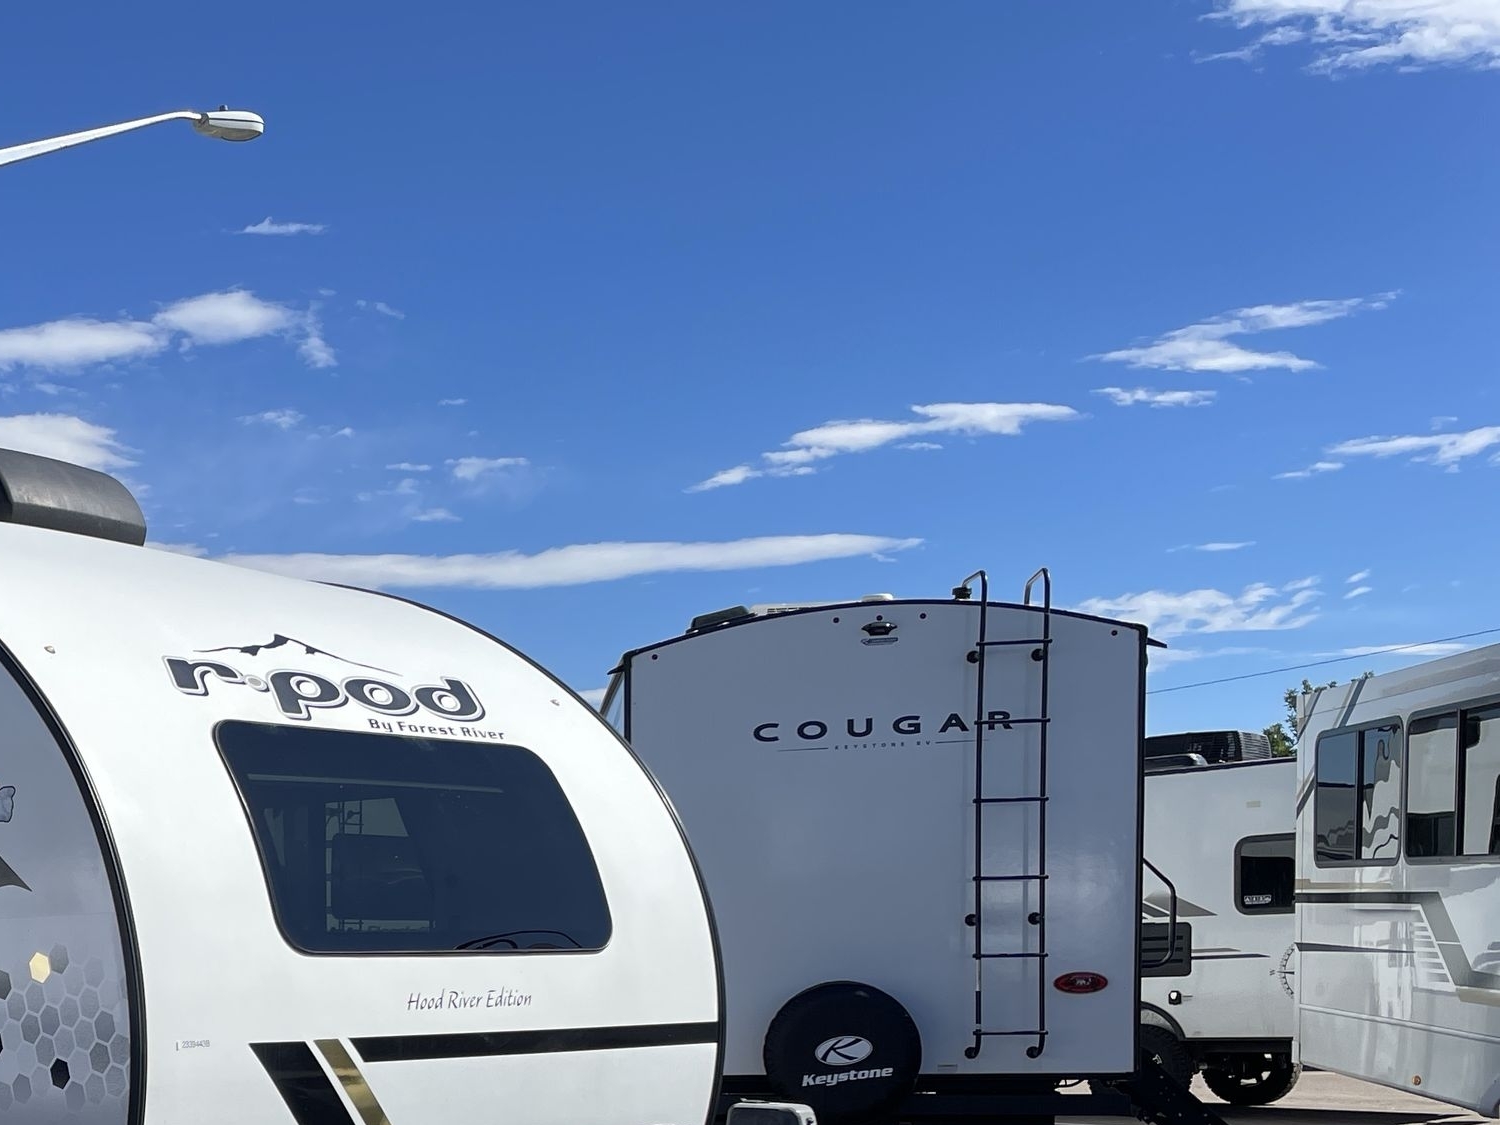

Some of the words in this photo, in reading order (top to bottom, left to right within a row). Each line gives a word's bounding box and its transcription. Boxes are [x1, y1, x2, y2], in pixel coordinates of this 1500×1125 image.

[367, 718, 393, 733] By
[397, 720, 455, 737] Forest
[461, 726, 506, 741] River
[752, 710, 1013, 742] COUGAR
[834, 741, 905, 750] KEYSTONE
[407, 988, 445, 1011] Hood
[448, 990, 483, 1009] River
[486, 985, 532, 1008] Edition
[802, 1067, 894, 1087] Keystone
